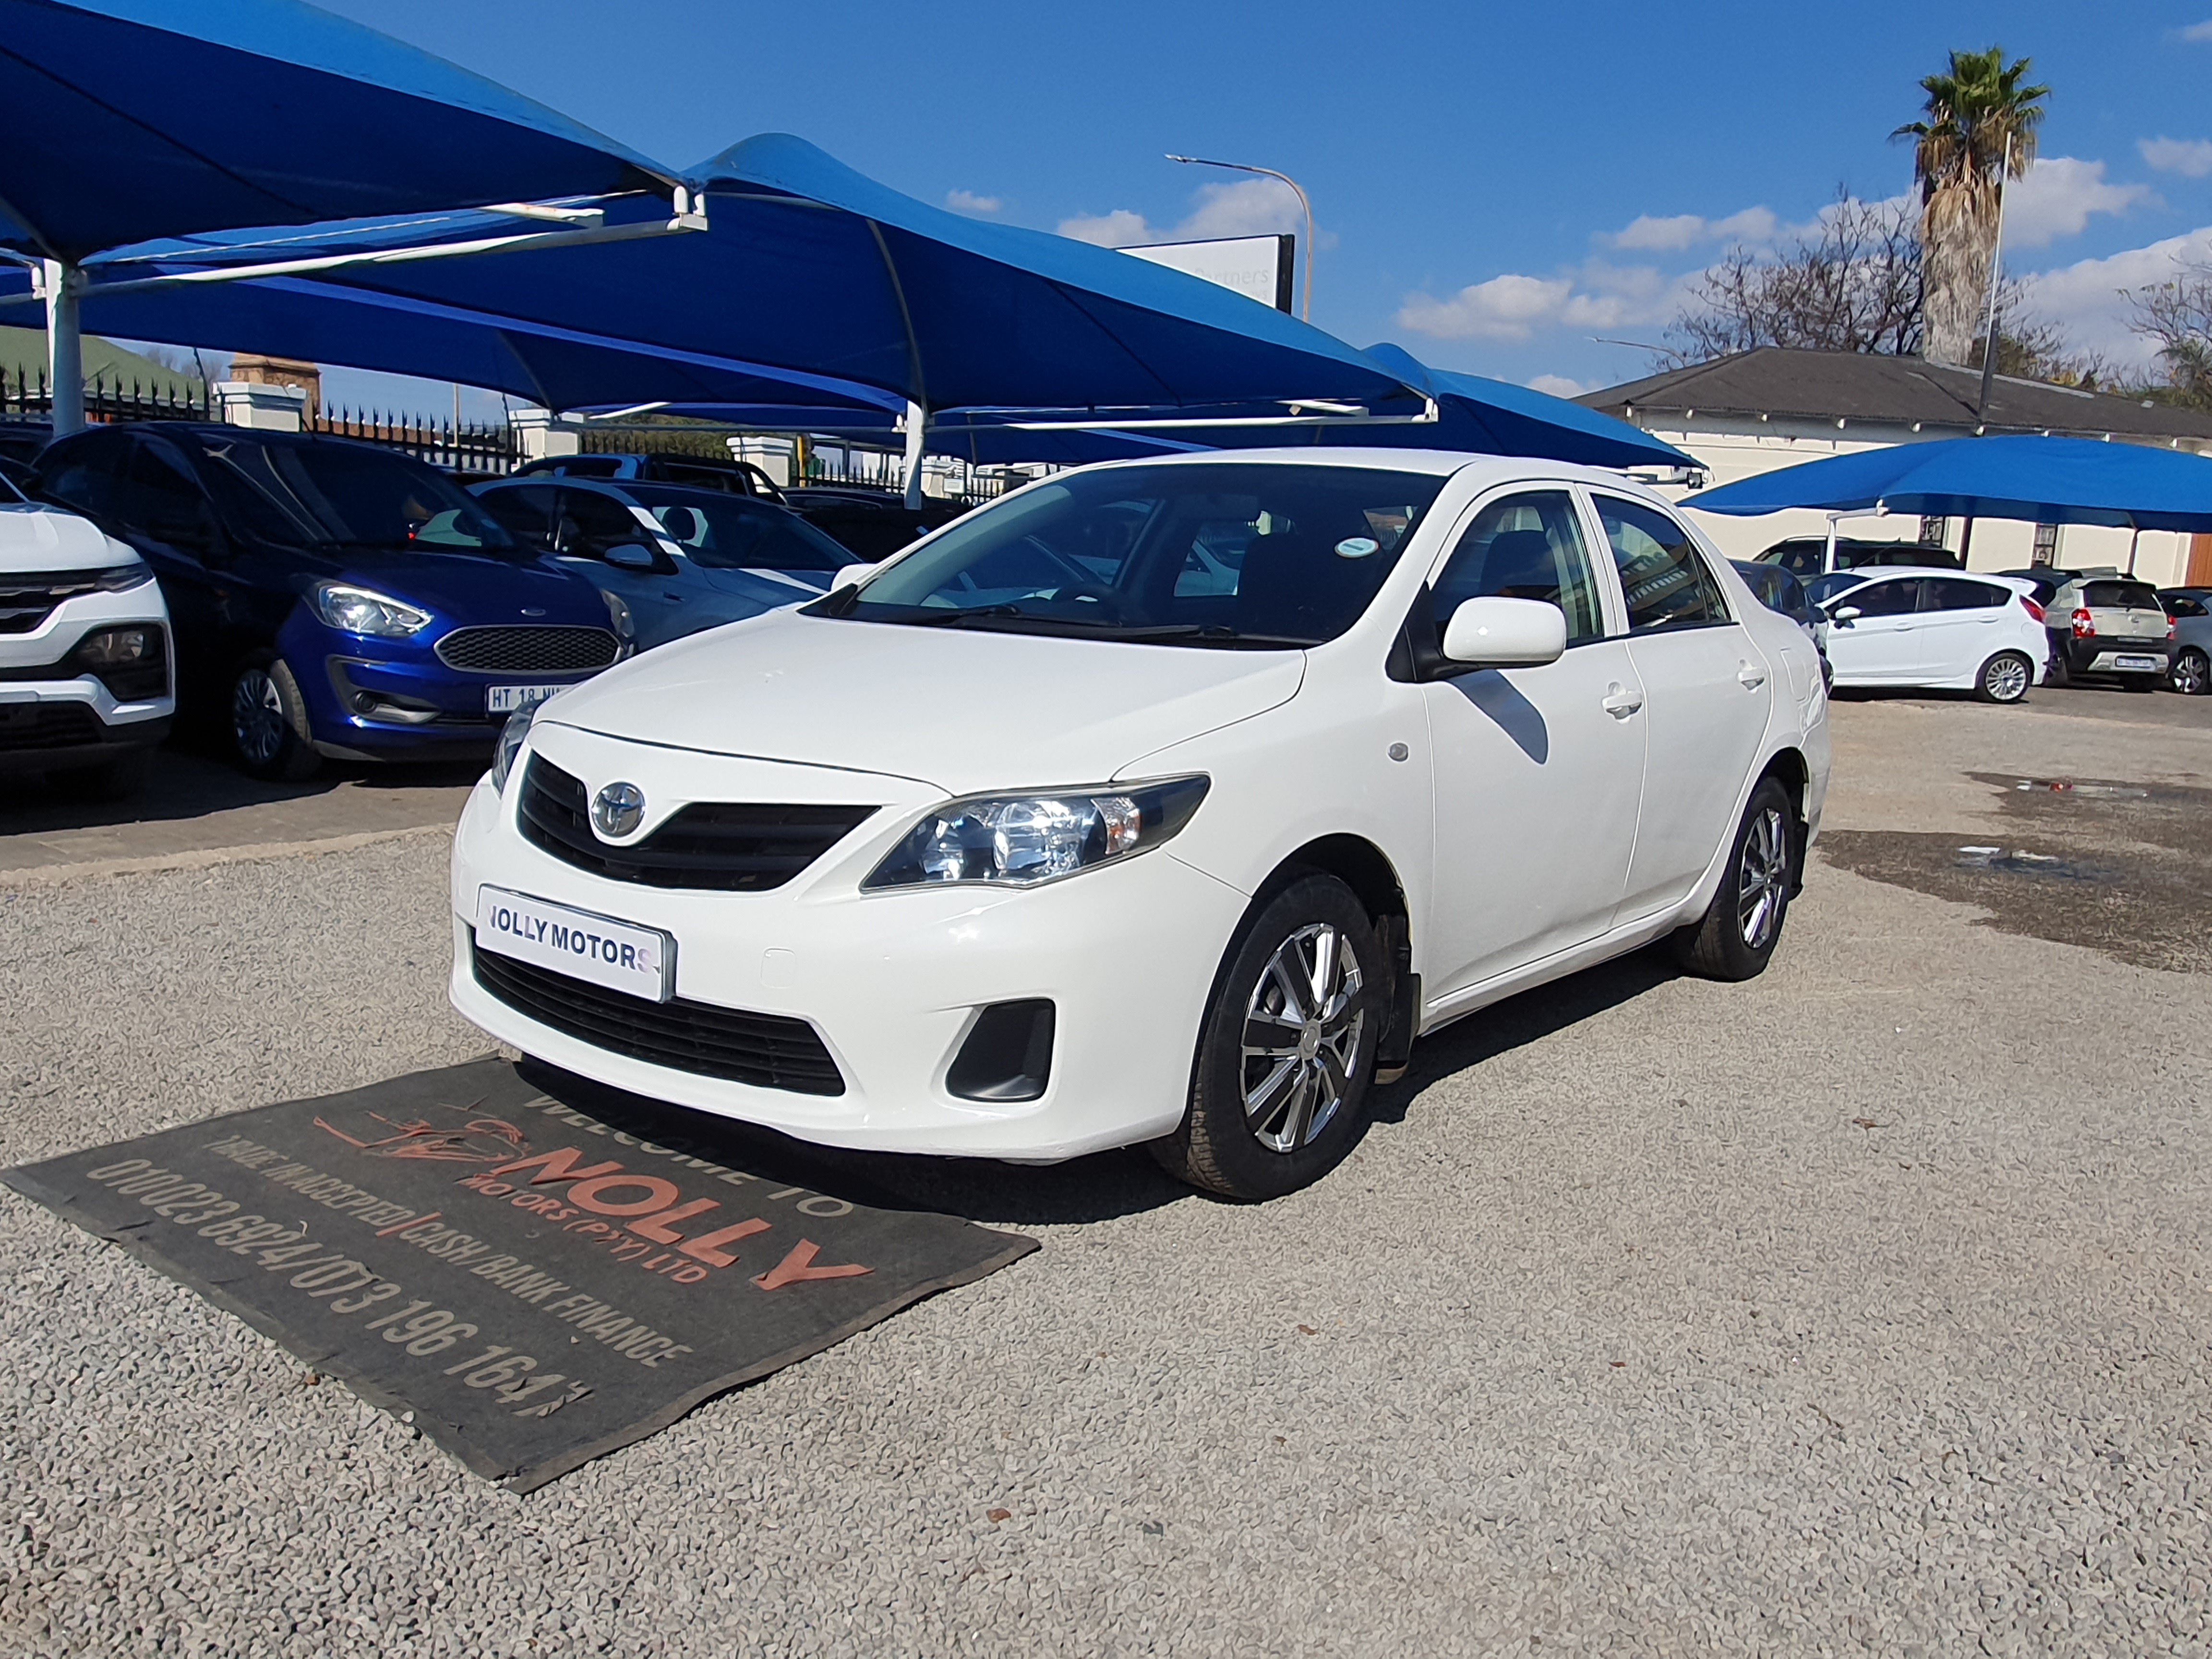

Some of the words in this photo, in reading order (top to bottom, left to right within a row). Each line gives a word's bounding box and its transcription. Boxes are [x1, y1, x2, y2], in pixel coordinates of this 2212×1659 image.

[493, 688, 510, 707] HT
[543, 687, 559, 699] N
[552, 924, 652, 974] MOTORS
[454, 1173, 579, 1220] MOTORS
[641, 1253, 709, 1284] LTD
[489, 1146, 876, 1290] NOLLY
[768, 1187, 854, 1217] TO
[364, 1298, 479, 1356] 196
[542, 1294, 694, 1368] FINANCE
